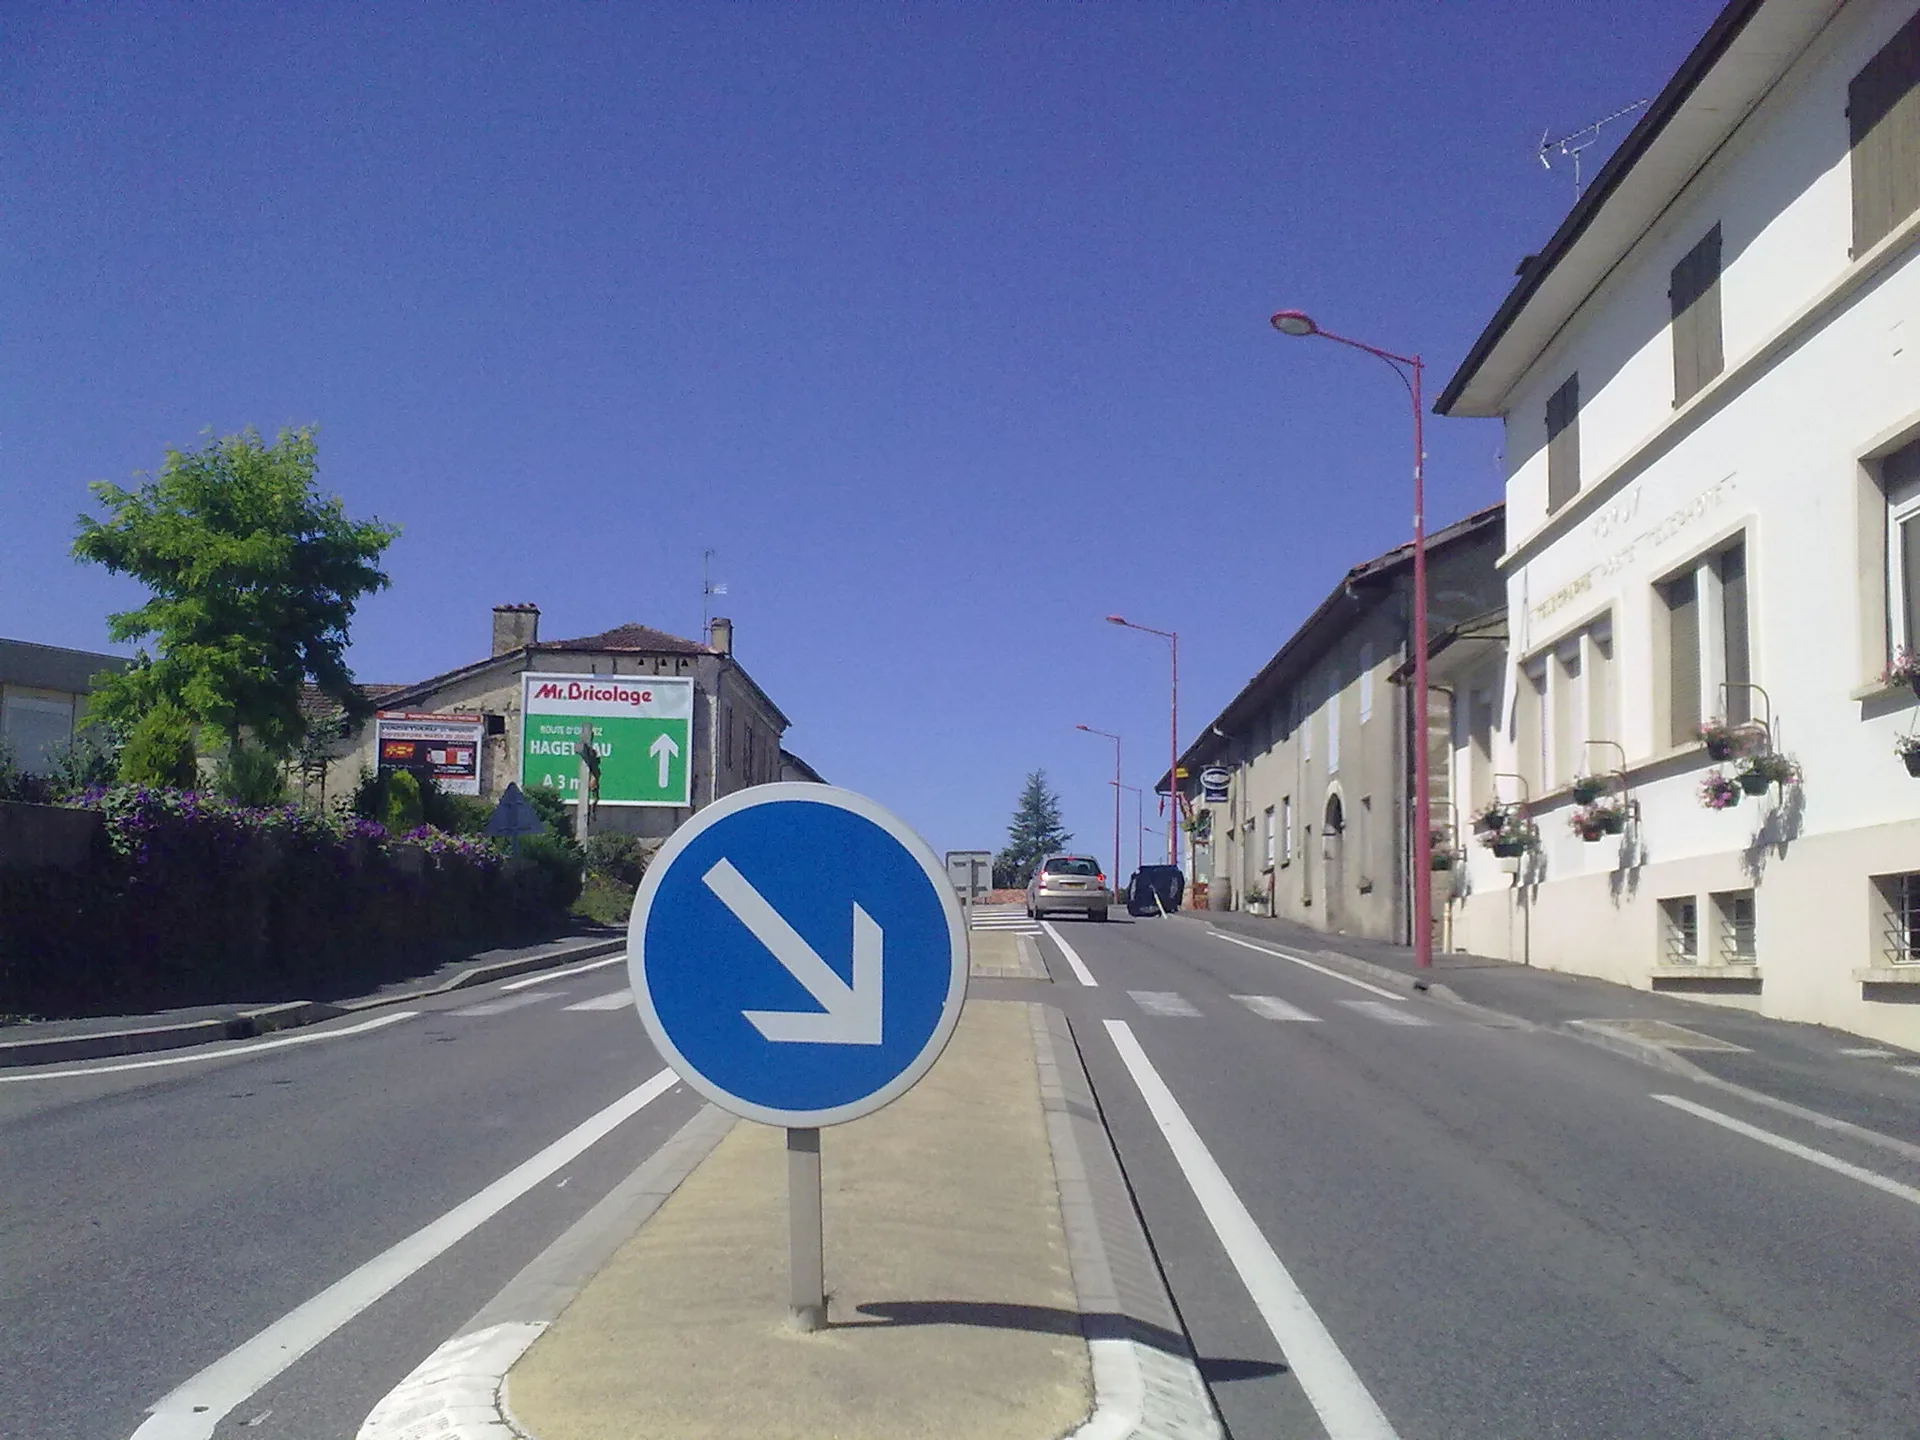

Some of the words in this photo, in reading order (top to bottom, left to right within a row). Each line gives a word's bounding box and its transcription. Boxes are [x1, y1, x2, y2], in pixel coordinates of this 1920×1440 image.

[540, 725, 564, 734] ROUTE
[530, 740, 611, 757] HAGETAU
[543, 774, 554, 788] A
[558, 774, 566, 789] 3
